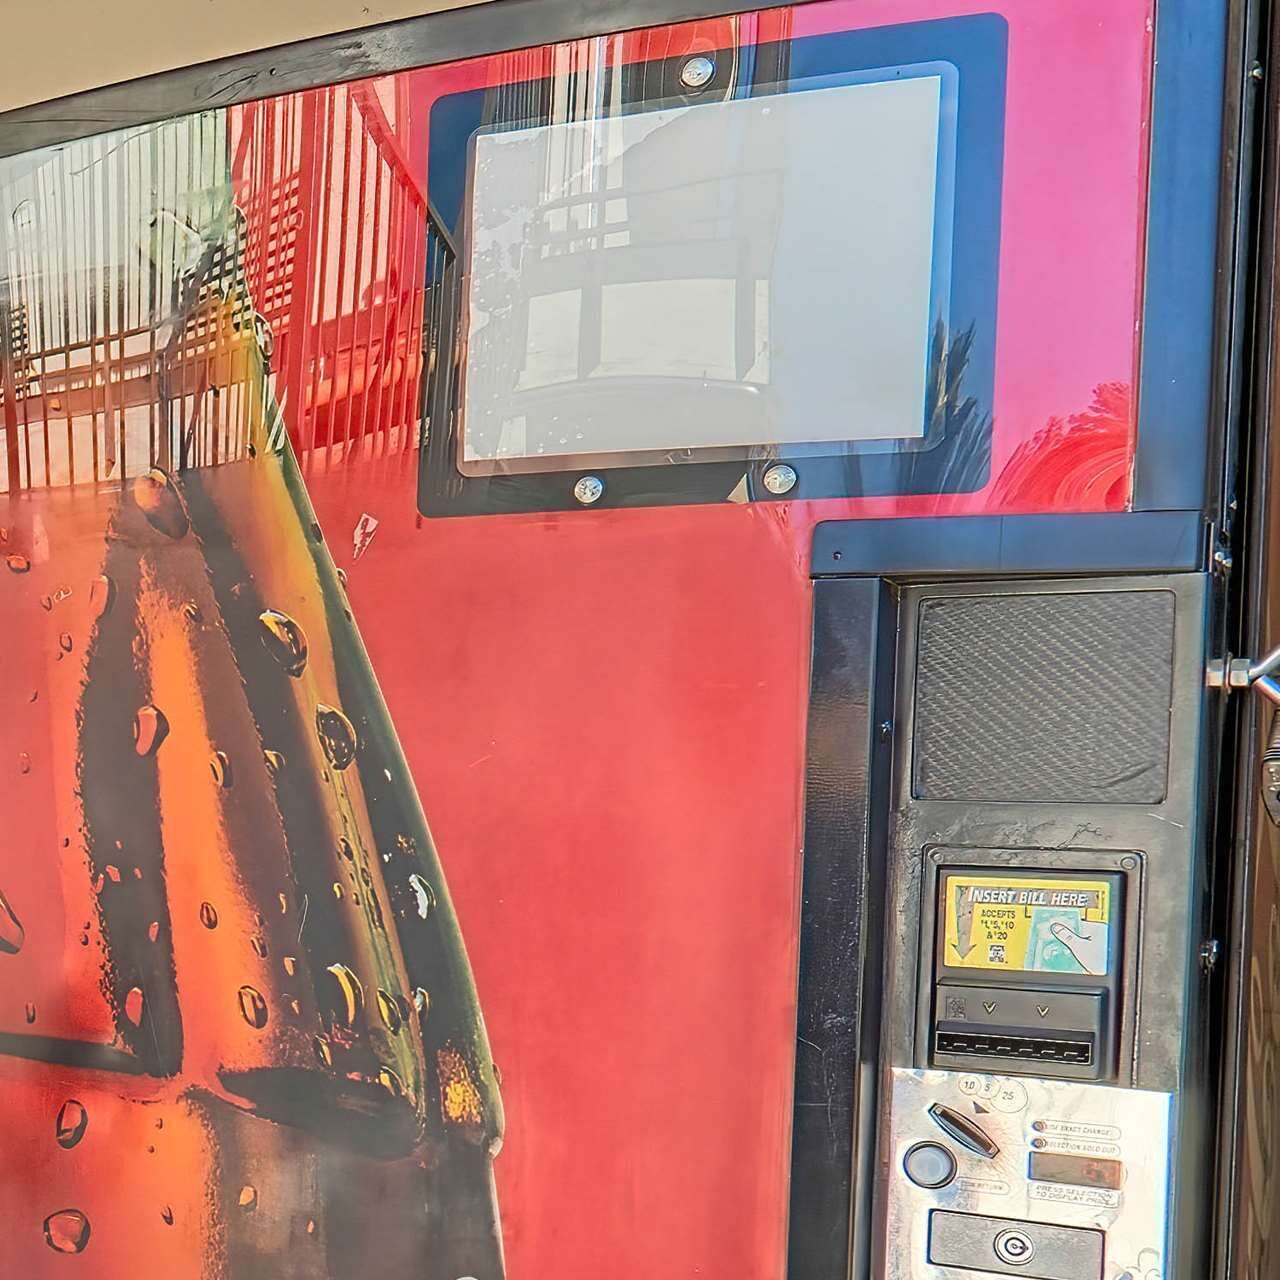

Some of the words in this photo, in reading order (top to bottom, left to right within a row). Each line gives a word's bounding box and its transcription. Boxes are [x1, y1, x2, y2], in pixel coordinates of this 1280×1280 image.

[967, 886, 1017, 904] INSERT
[1019, 889, 1047, 906] BILL
[1050, 892, 1090, 907] HERE
[981, 909, 1016, 919] ACCEPTS
[963, 1080, 976, 1091] 10
[983, 1082, 992, 1093] 5
[1001, 1090, 1015, 1101] 25
